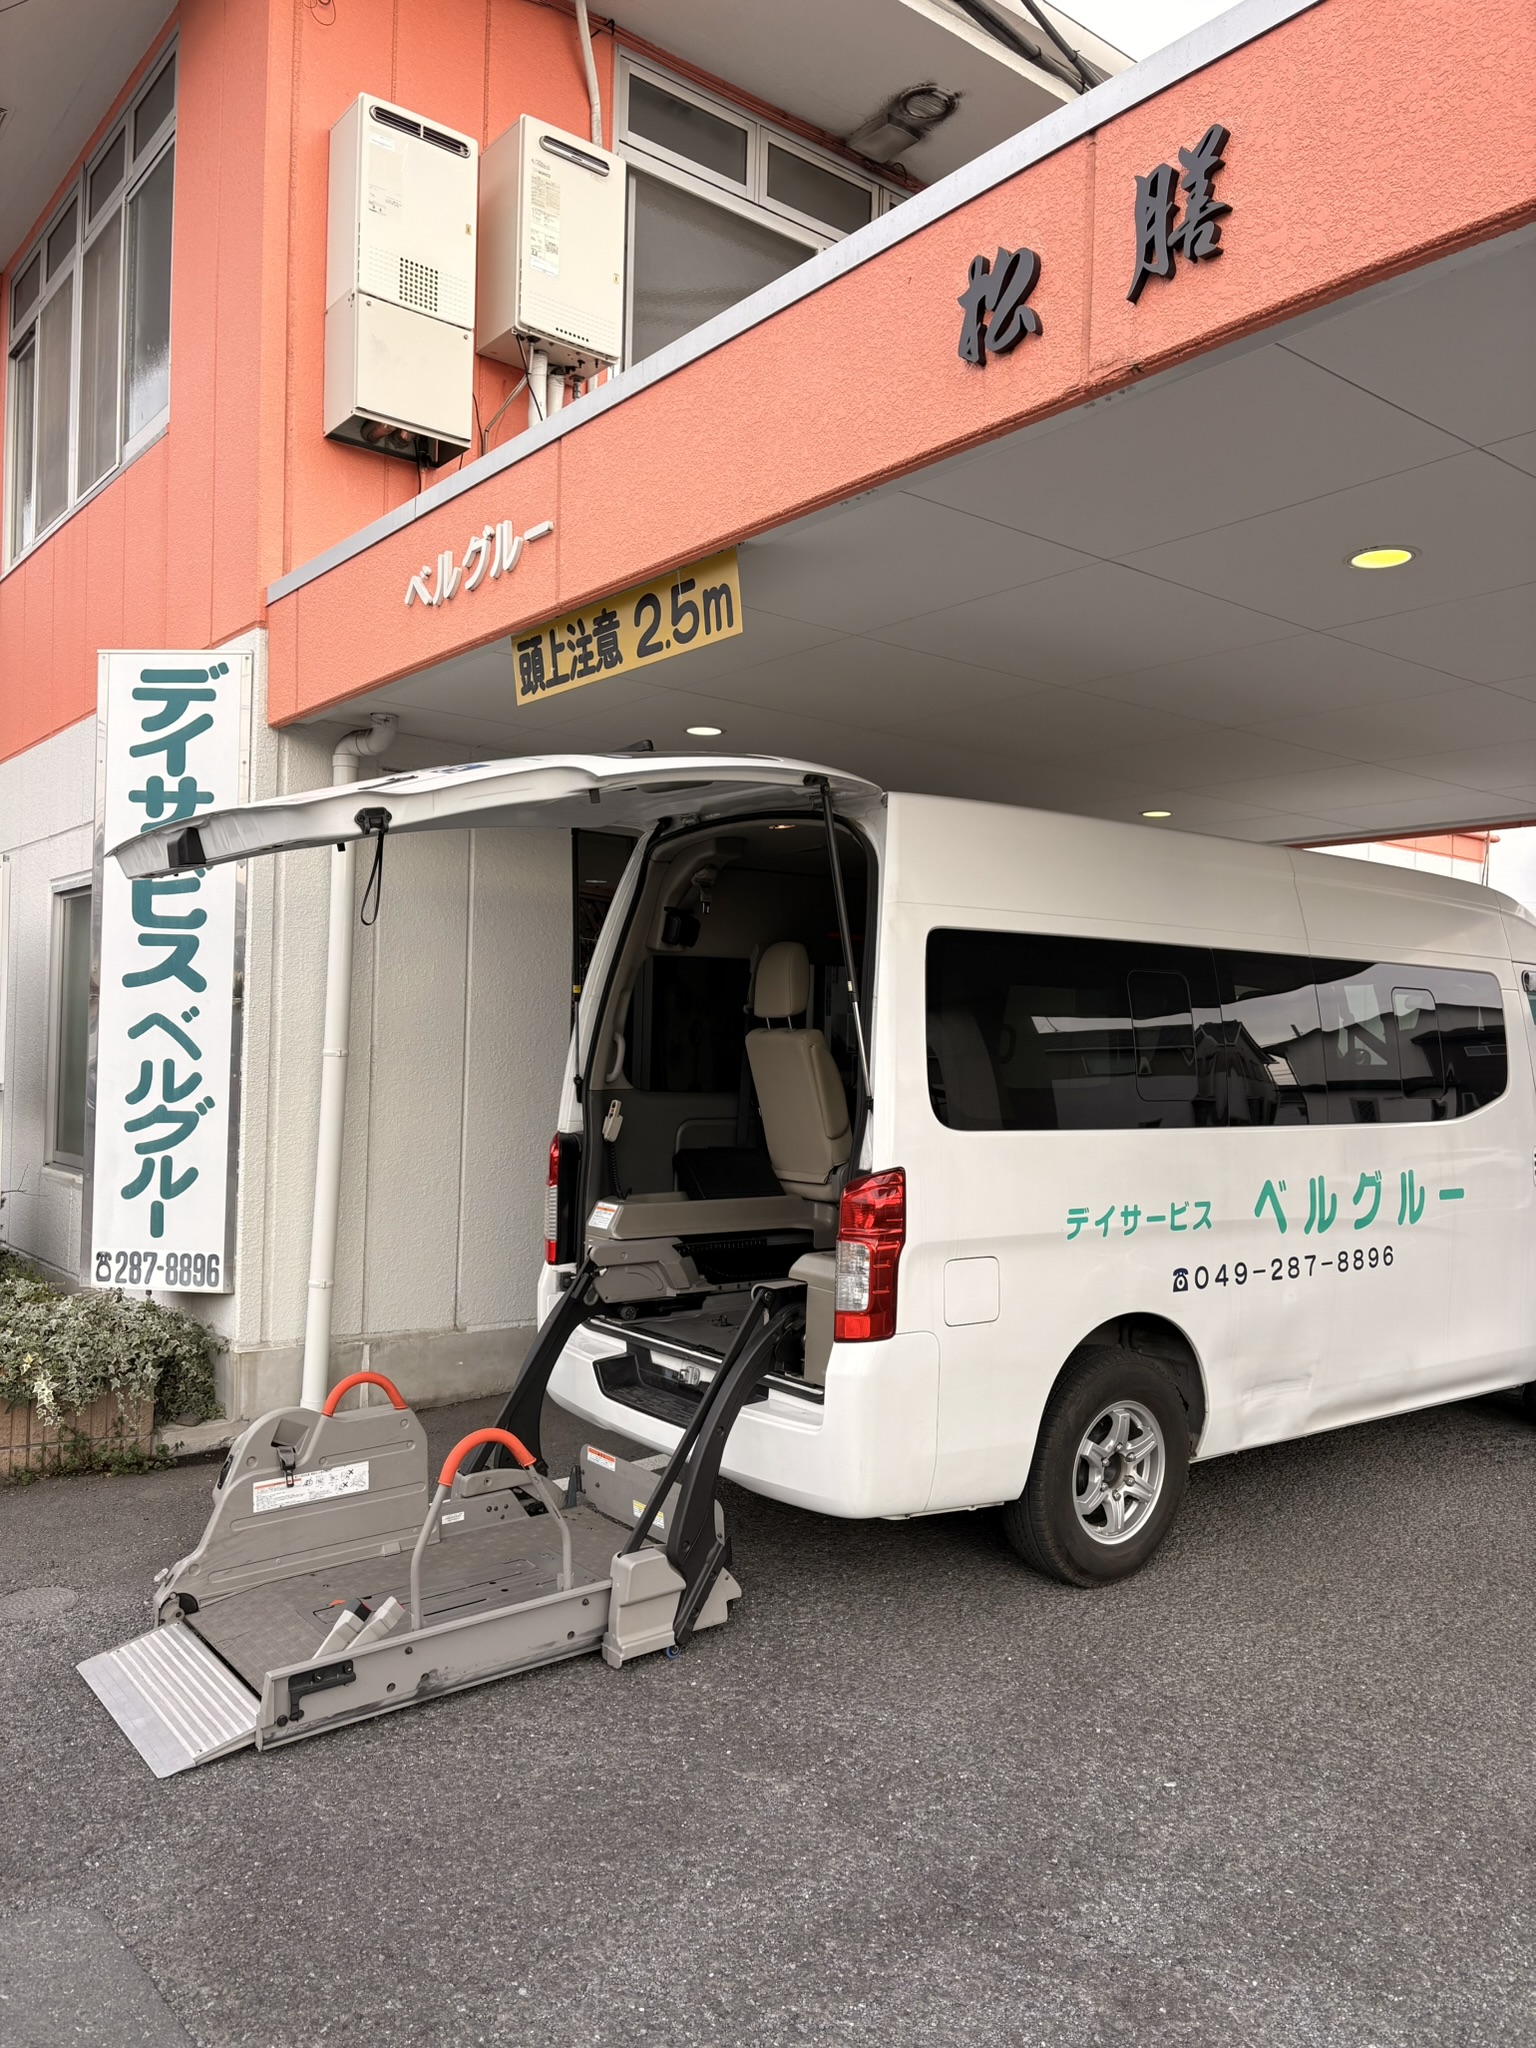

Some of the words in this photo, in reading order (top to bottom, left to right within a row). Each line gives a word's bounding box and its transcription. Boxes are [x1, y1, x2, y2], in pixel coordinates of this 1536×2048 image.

[405, 520, 554, 607] ベルグルー
[517, 608, 623, 696] 頭上注意
[634, 578, 734, 659] 2.5m
[122, 662, 230, 993] デイサビス
[121, 1006, 216, 1238] ベルグルー
[1067, 1201, 1212, 1240] デイサービス
[1254, 1169, 1465, 1235] ベルグルー
[115, 1251, 220, 1287] 287-8896
[1194, 1246, 1394, 1290] 049-287-8896
